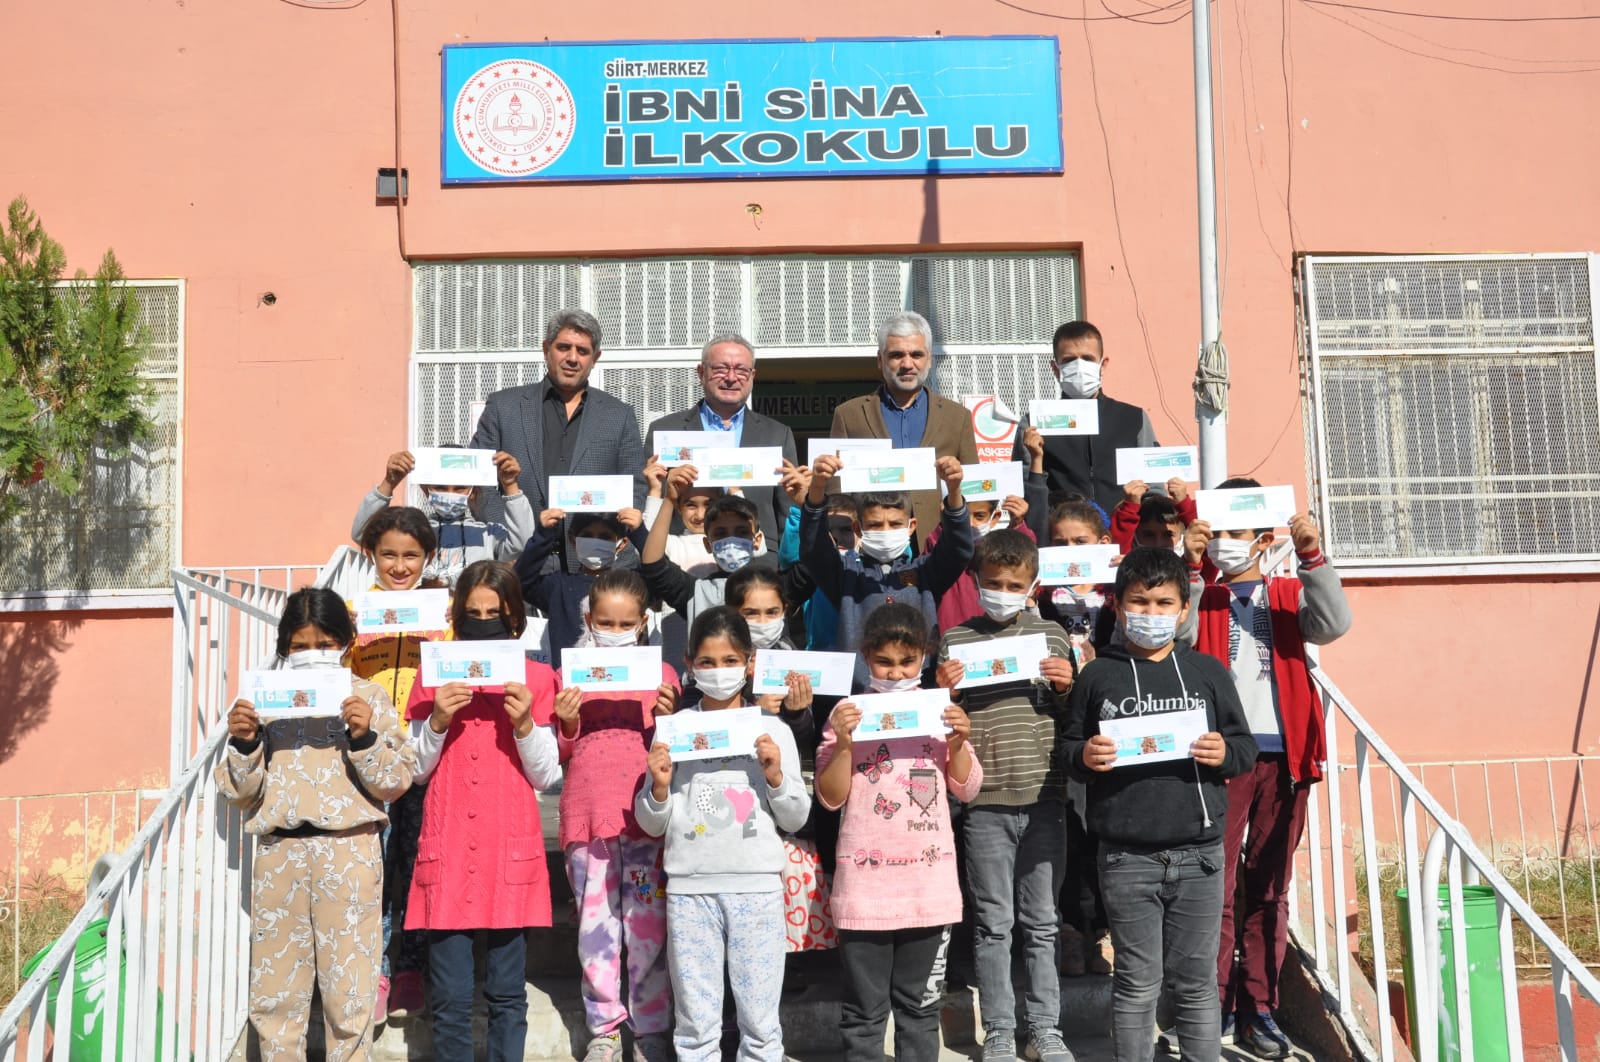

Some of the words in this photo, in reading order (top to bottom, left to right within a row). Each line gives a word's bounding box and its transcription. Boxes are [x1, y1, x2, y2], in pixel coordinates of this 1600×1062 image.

[606, 60, 706, 77] SİİRT-MERKEZ
[606, 84, 739, 121] İBNİ
[766, 82, 926, 119] SİNA
[606, 126, 1027, 165] İLKOKULU
[752, 397, 821, 415] VMEKLE
[1120, 692, 1206, 715] Columbia
